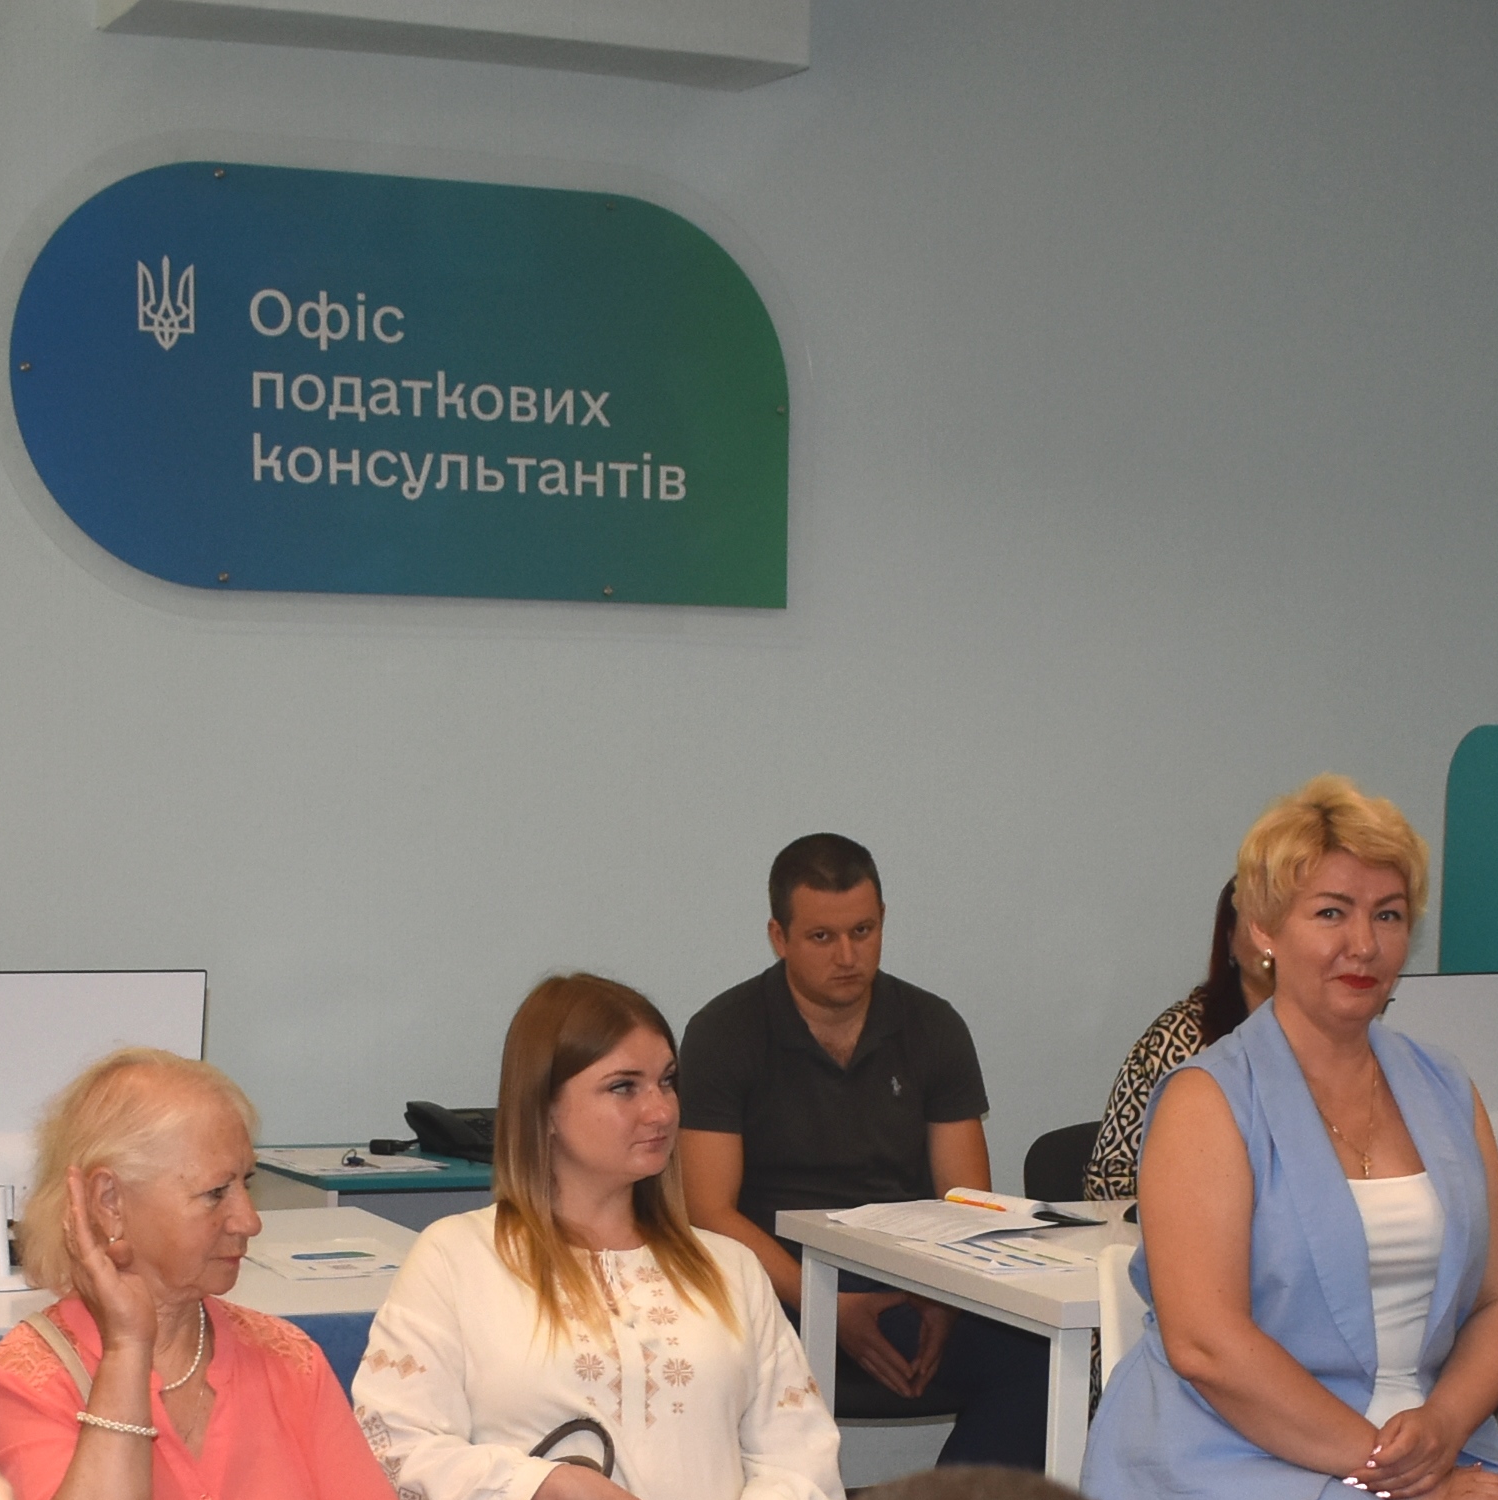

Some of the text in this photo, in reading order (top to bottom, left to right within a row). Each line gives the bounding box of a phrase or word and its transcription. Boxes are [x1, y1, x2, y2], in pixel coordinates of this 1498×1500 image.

[249, 288, 406, 351] Офіс
[251, 370, 612, 428] податкових
[252, 432, 688, 501] консультантів
